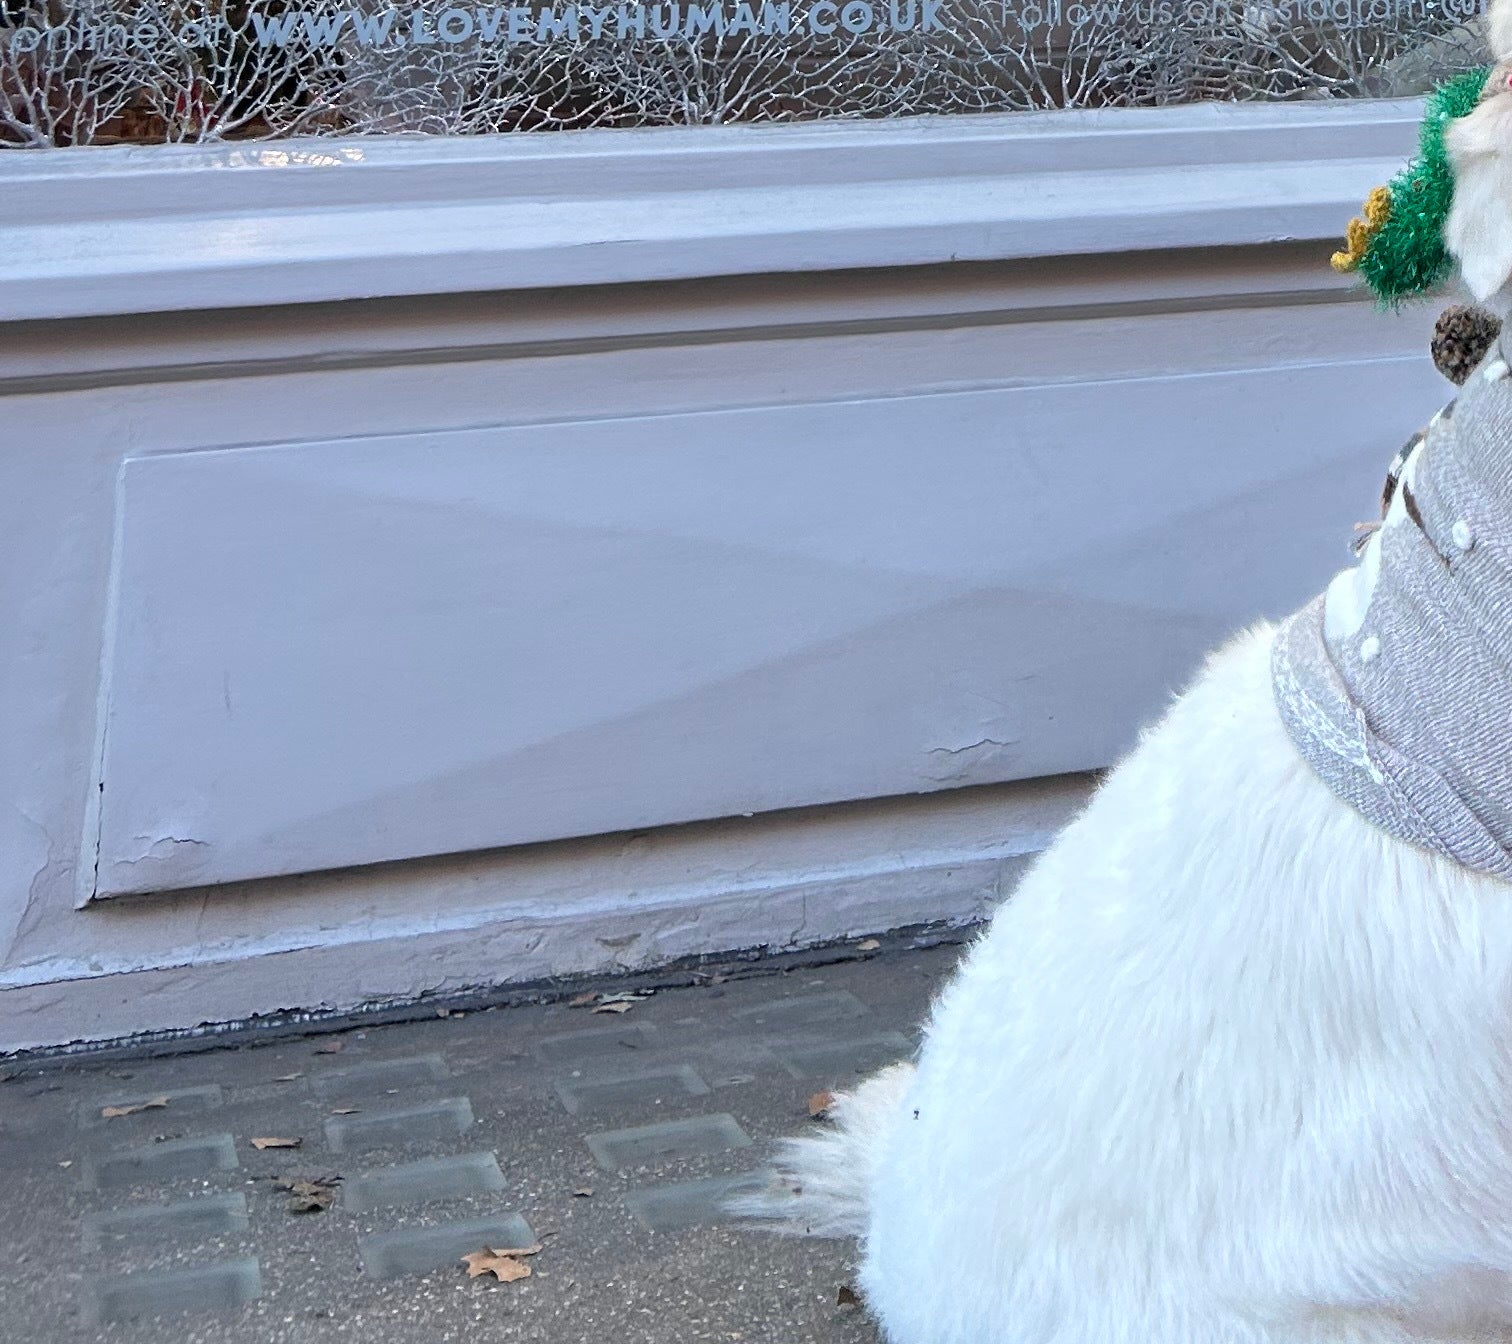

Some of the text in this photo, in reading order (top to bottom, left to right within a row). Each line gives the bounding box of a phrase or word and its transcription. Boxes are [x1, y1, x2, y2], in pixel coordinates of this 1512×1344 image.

[12, 14, 160, 52] online
[179, 15, 223, 48] at
[1135, 1, 1174, 25] us
[1187, 1, 1231, 25] on
